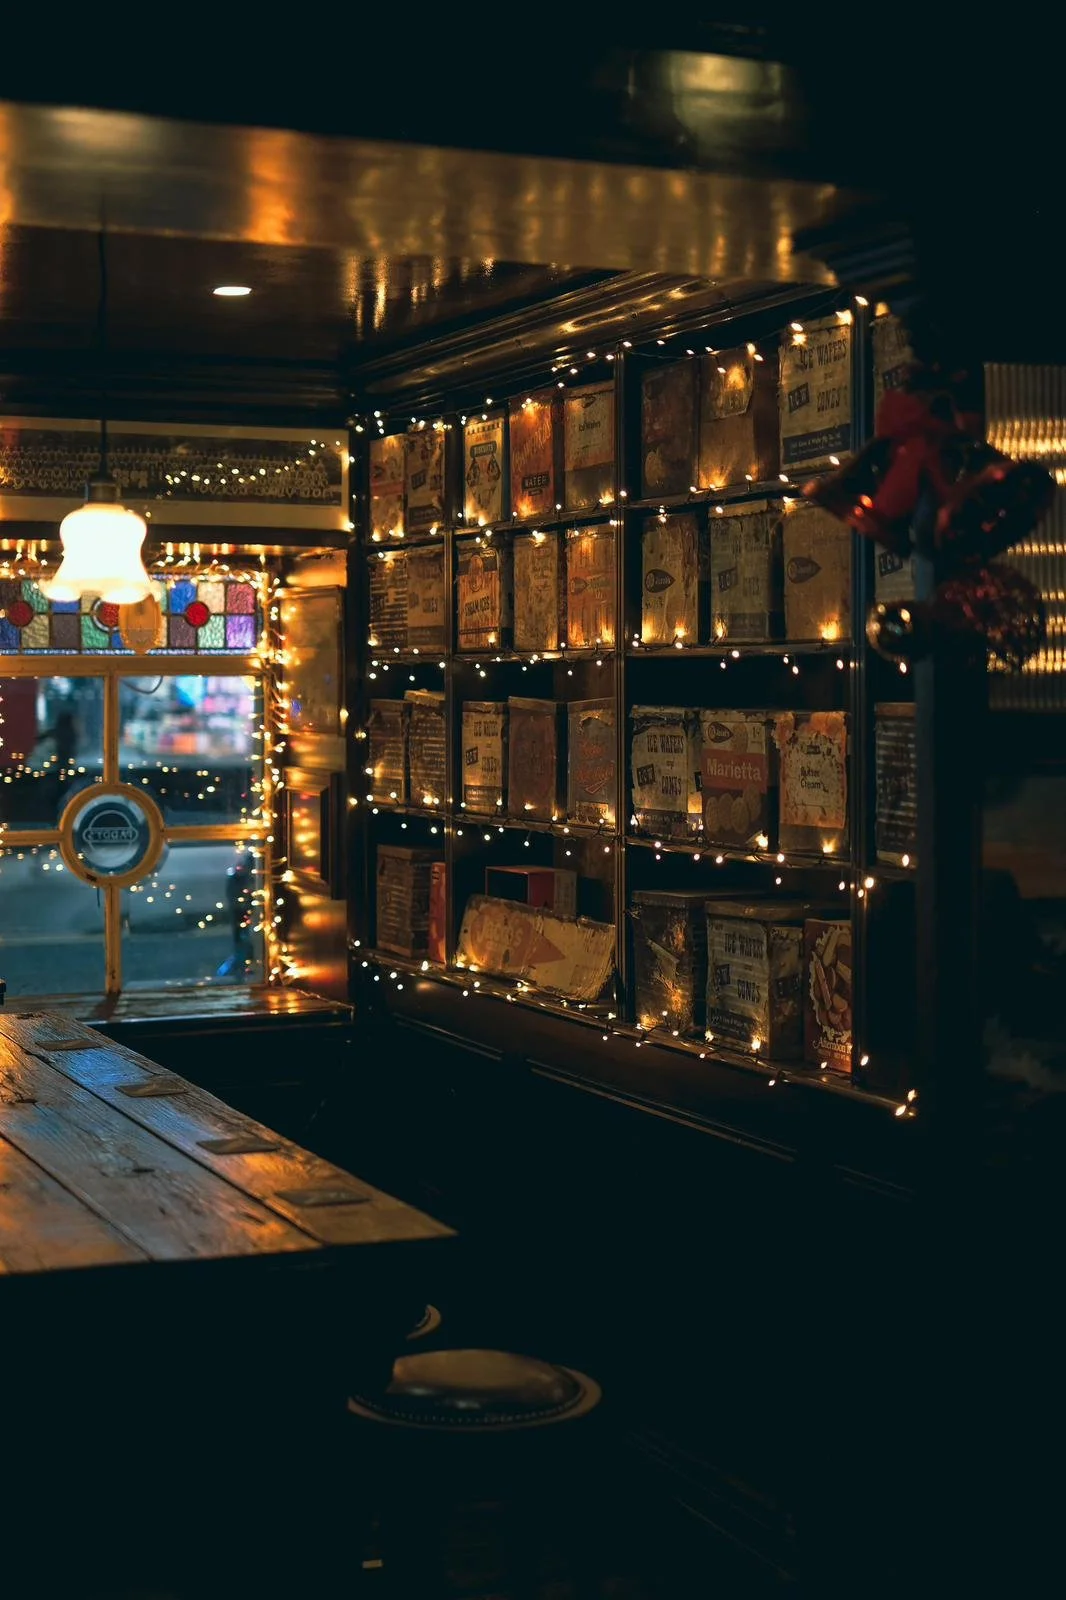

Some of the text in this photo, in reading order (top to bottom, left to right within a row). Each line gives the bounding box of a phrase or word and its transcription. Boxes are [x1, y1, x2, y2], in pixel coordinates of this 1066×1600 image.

[647, 735, 684, 753] ICE WAFERS
[706, 758, 762, 781] Marietta
[662, 776, 682, 795] CONES
[737, 979, 761, 1004] CONES
